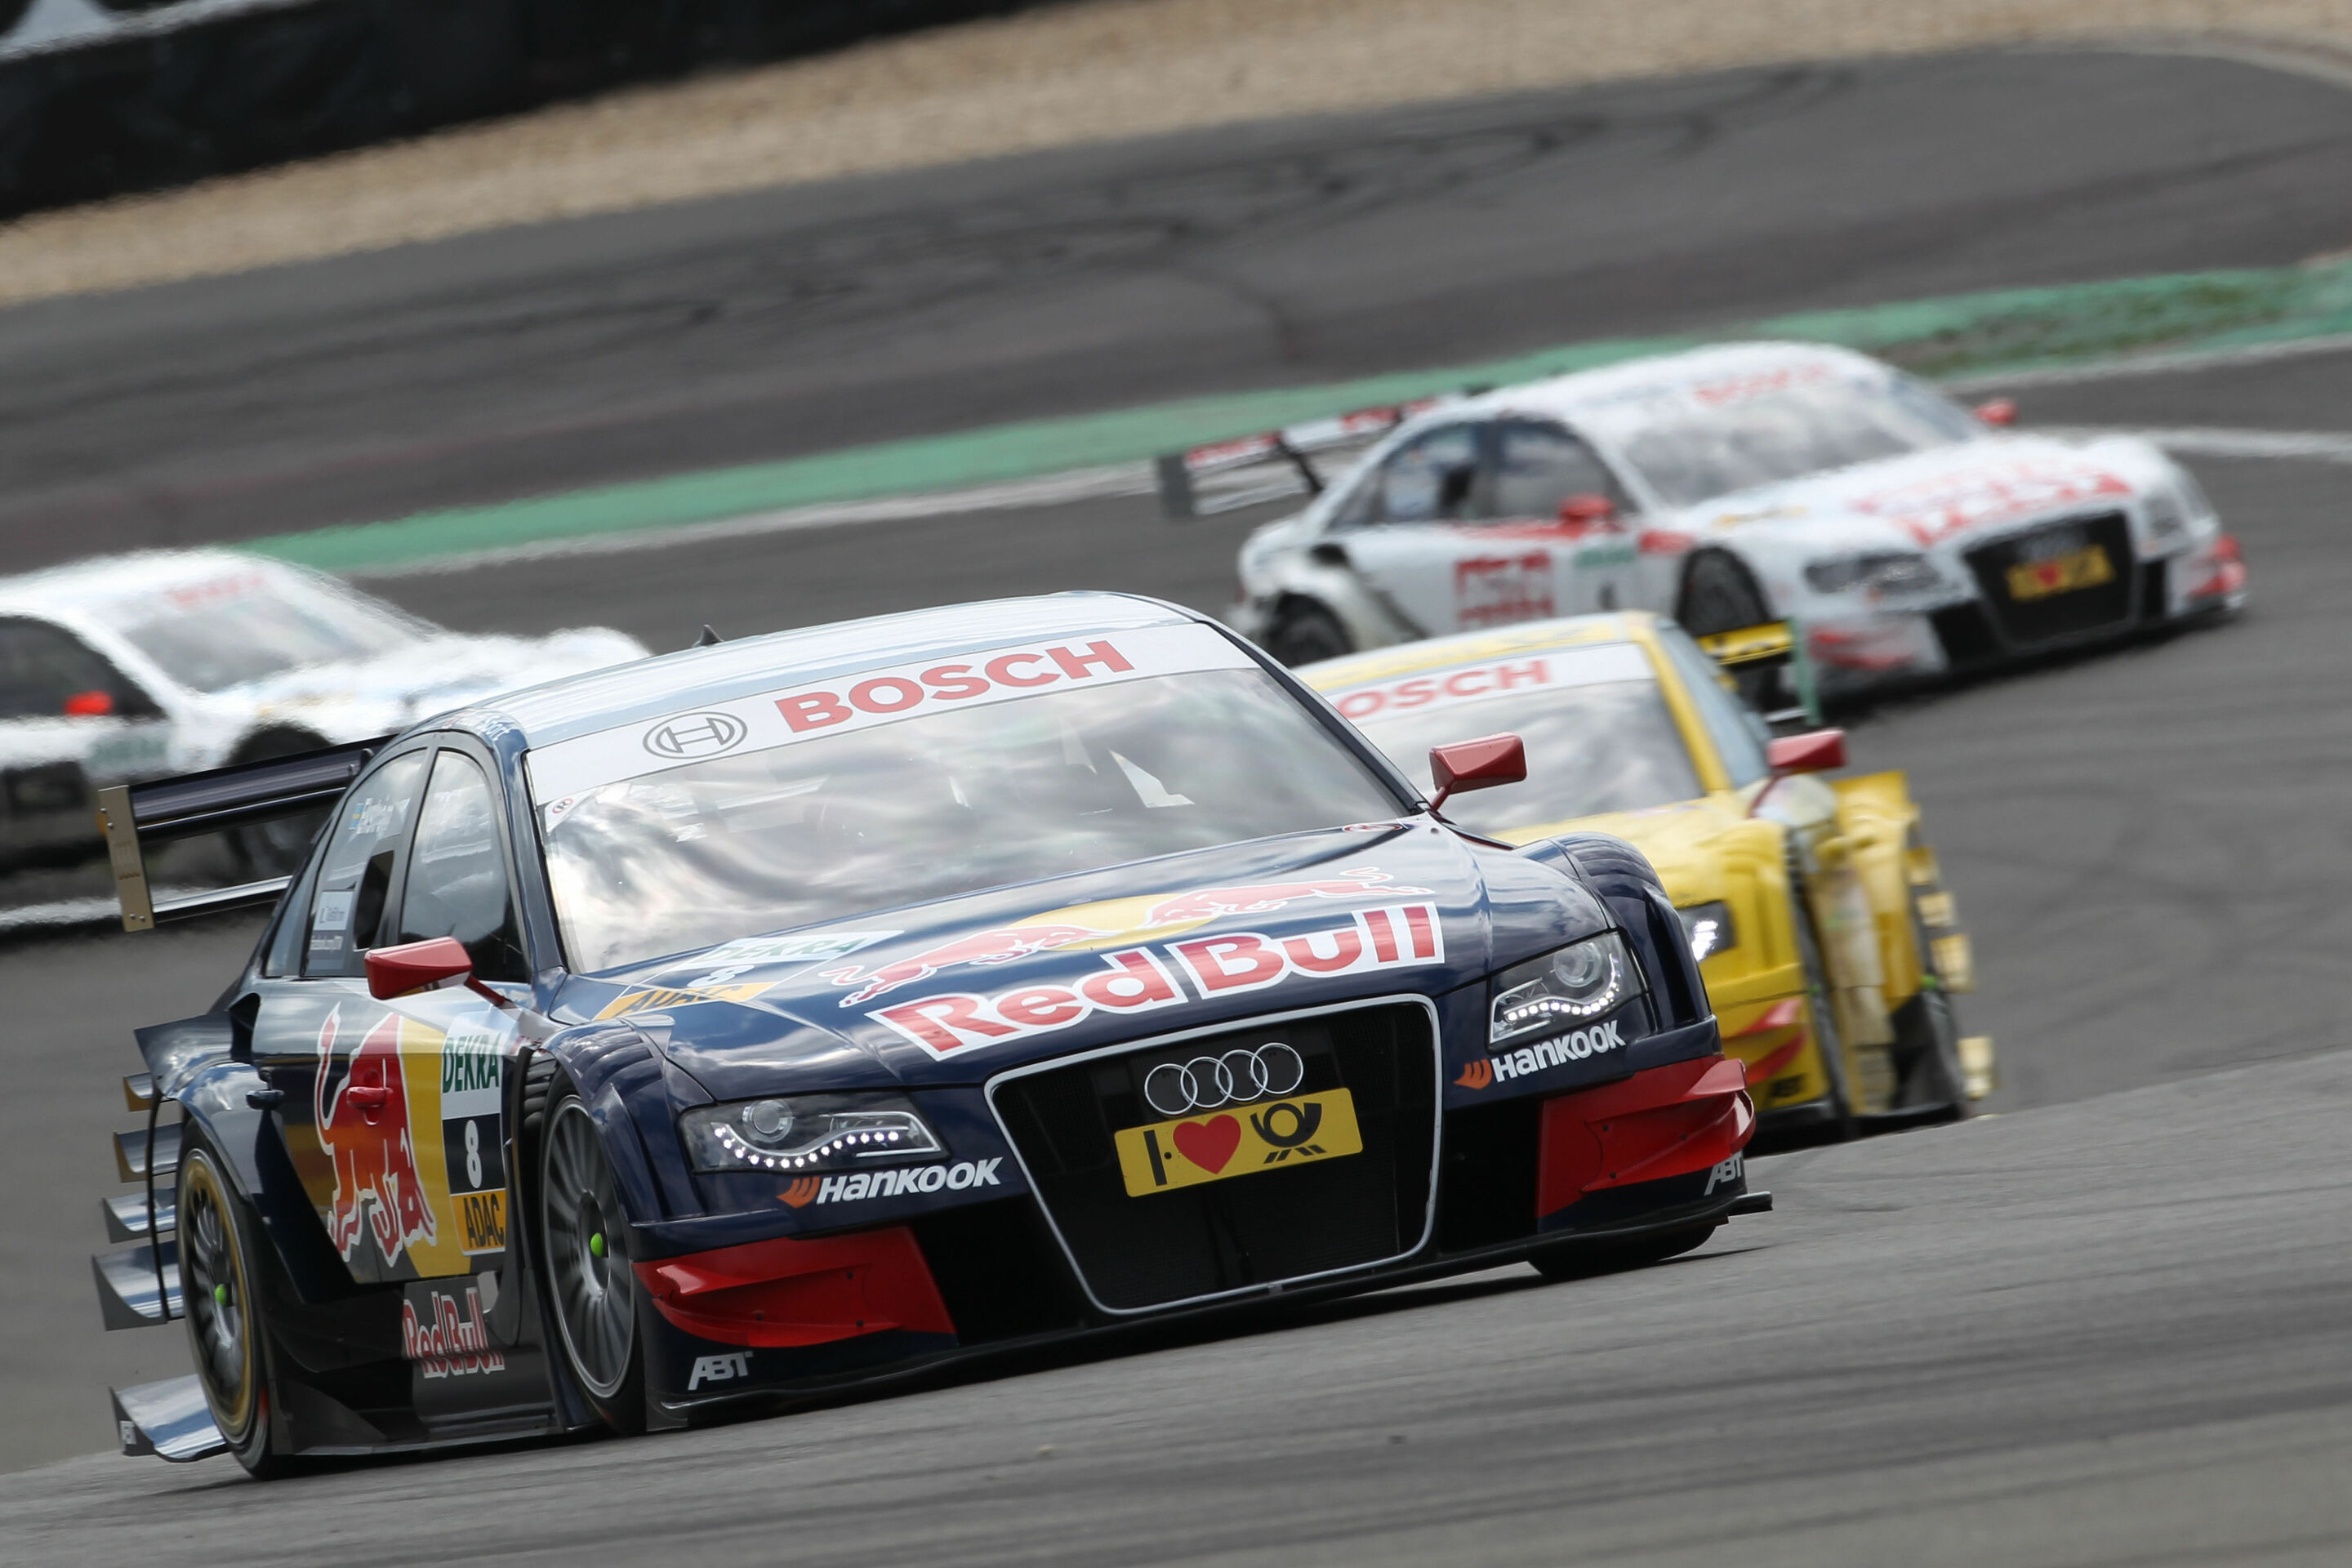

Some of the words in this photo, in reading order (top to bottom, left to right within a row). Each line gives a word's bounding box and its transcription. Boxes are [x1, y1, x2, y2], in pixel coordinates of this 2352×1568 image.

[774, 640, 1134, 733] BOSCH
[1336, 659, 1549, 719] OSCH
[687, 964, 755, 987] 8
[866, 951, 1187, 1061] Red
[1164, 902, 1445, 1000] Bull
[443, 1033, 501, 1094] DEKRA
[465, 1119, 483, 1189] 8
[1704, 1150, 1743, 1196] ABT
[463, 1193, 505, 1249] ADAC
[688, 1352, 754, 1391] ABT
